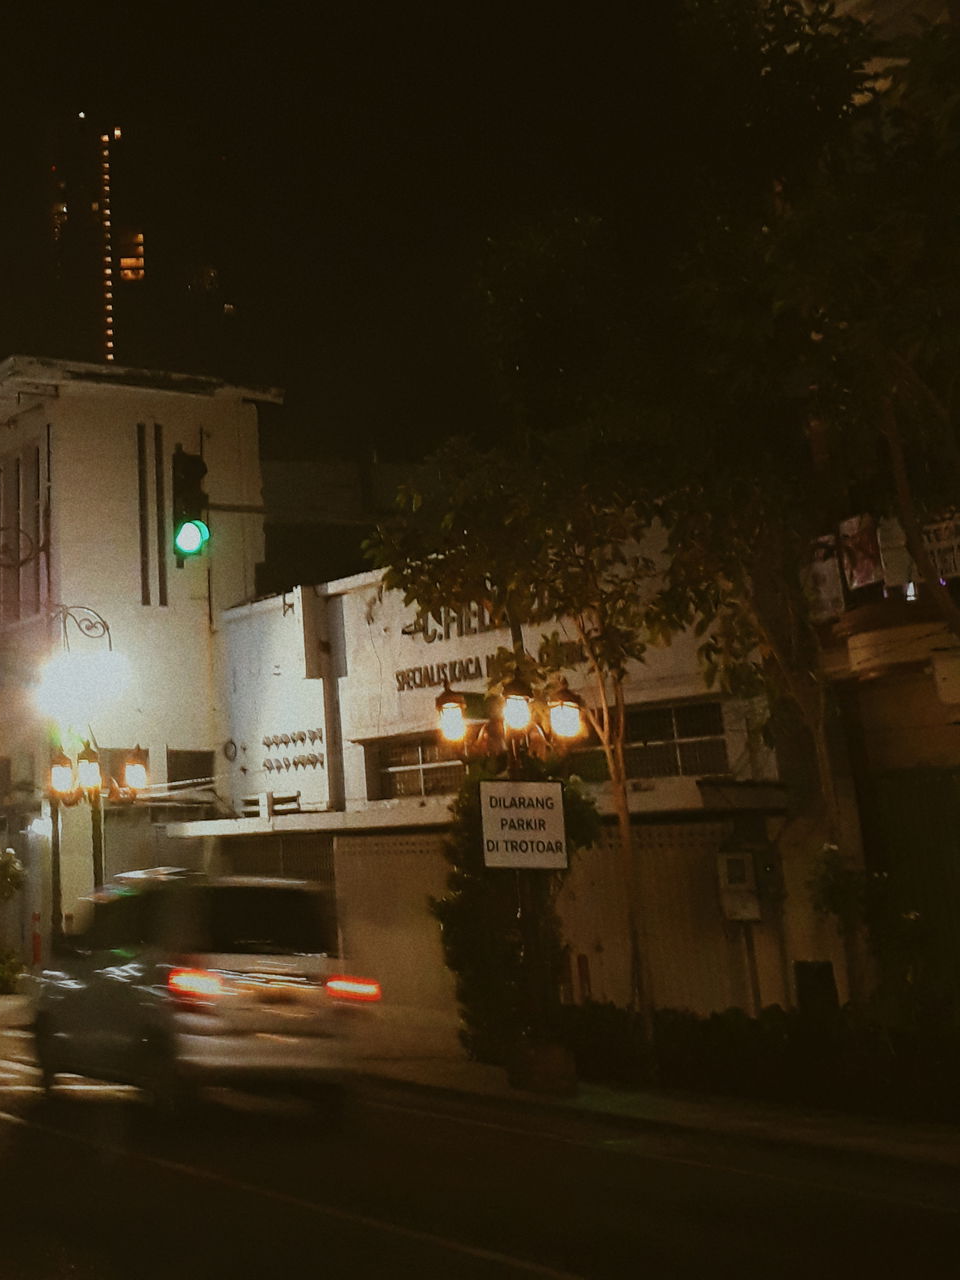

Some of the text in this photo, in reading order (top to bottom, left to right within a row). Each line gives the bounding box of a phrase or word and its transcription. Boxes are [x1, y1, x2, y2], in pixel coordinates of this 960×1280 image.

[449, 656, 483, 682] KACA
[489, 795, 554, 810] DILARANG
[500, 818, 546, 831] PARKIR
[486, 839, 564, 854] DI TROTOAR
